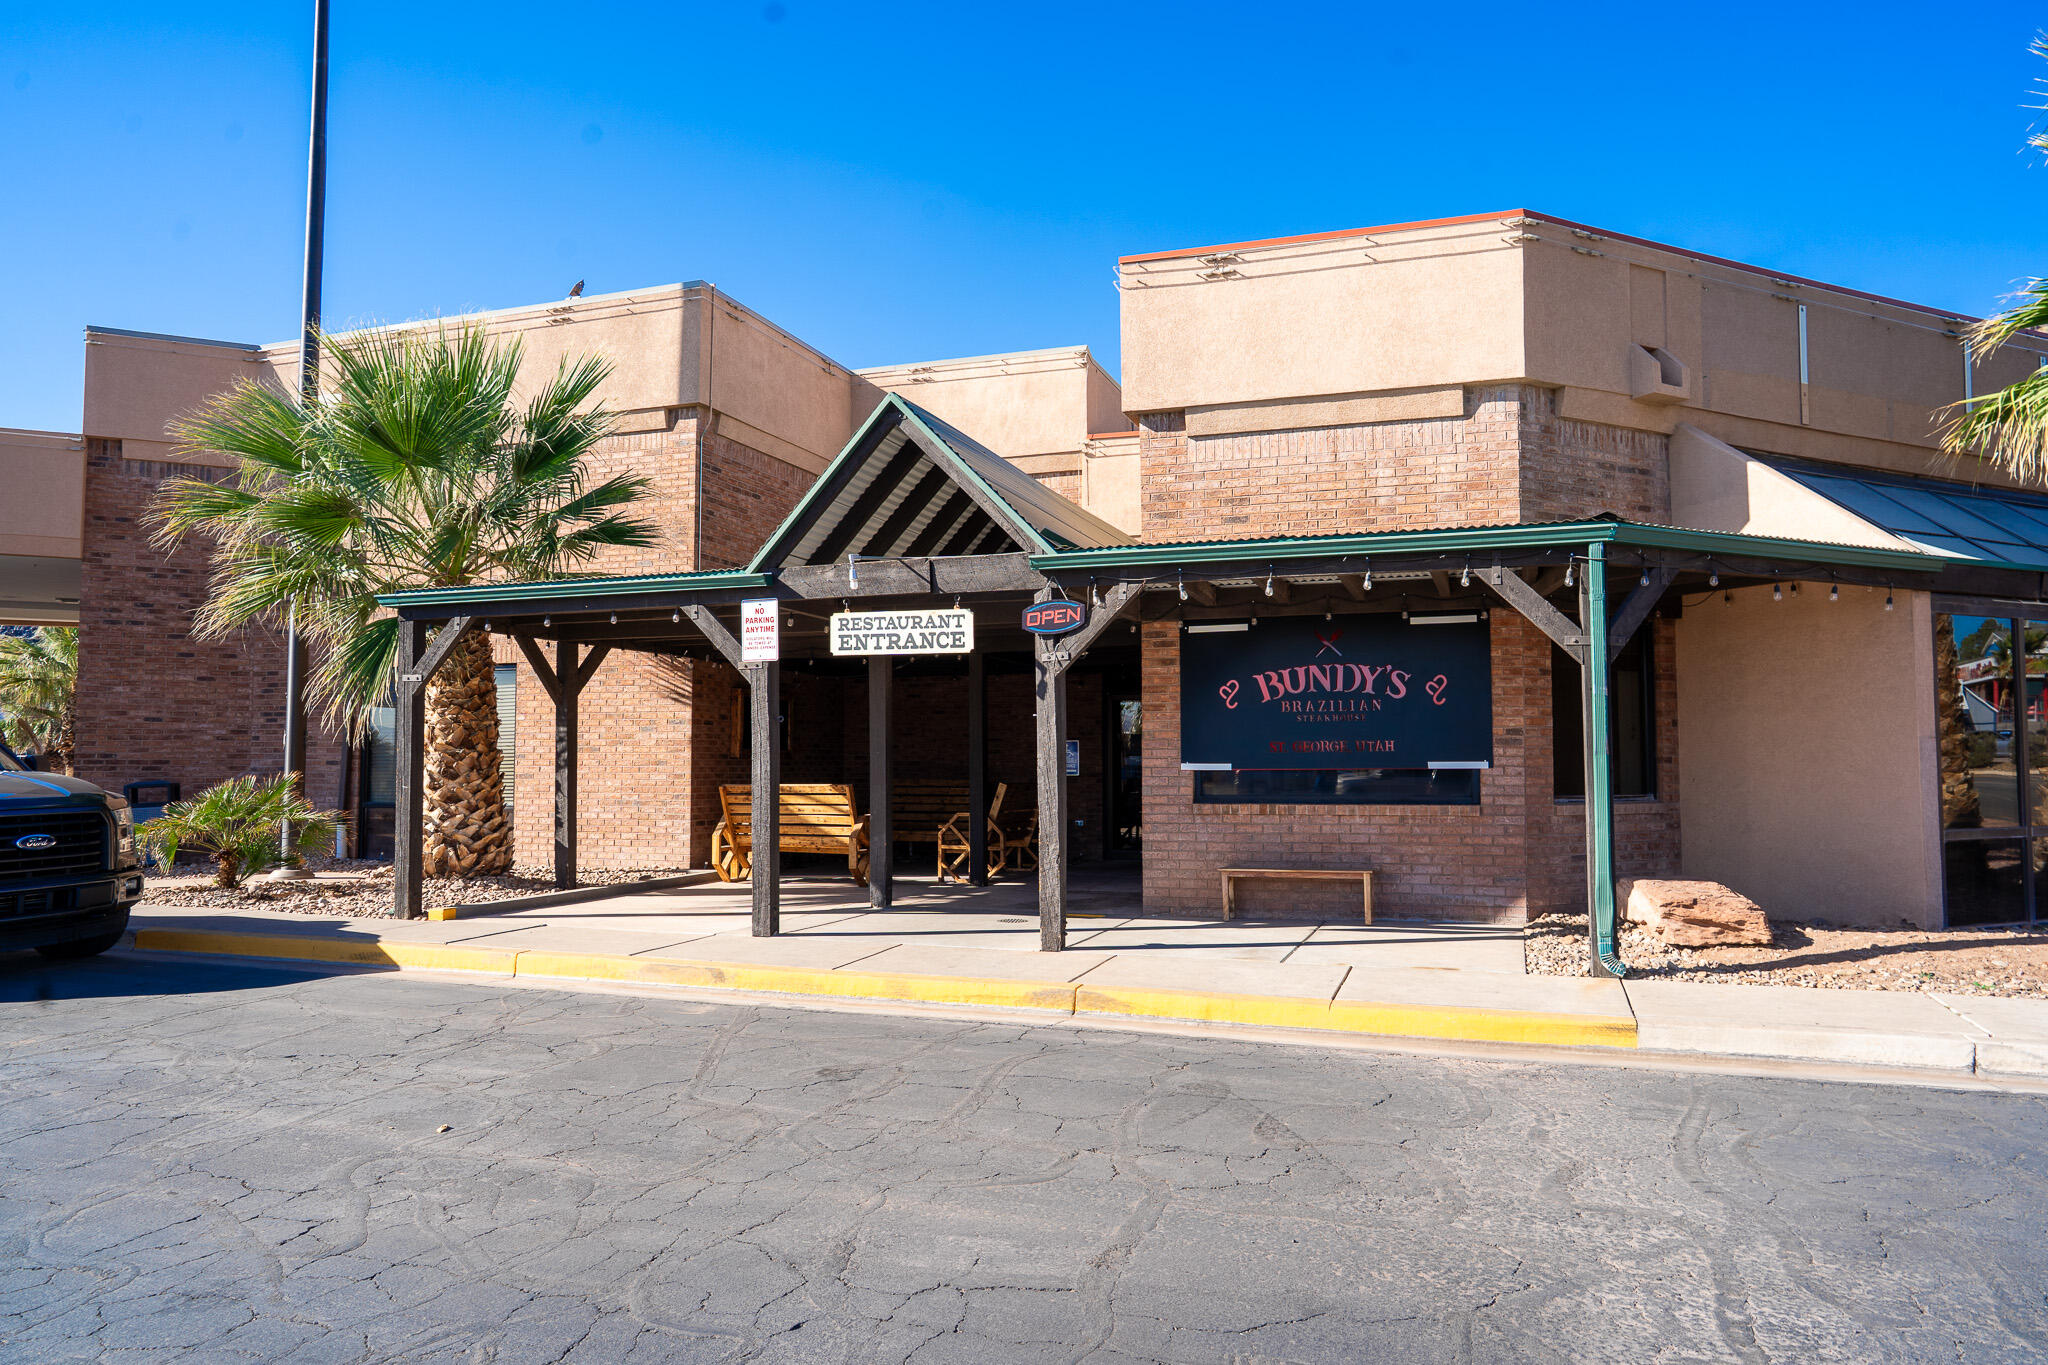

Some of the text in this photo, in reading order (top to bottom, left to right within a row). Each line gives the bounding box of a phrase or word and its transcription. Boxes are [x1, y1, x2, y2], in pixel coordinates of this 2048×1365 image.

[755, 607, 764, 615] NO
[1026, 607, 1081, 627] OPEN
[745, 616, 775, 624] PARKING
[837, 614, 966, 632] RESTAURANT
[745, 625, 775, 633] ANYTIME
[838, 631, 966, 651] ENTRANCE
[1251, 662, 1412, 703] BUNDY'S
[1280, 699, 1382, 713] BRAZILIAN
[1296, 713, 1367, 722] STEAKHOUSE
[1355, 739, 1395, 753] UTAH
[26, 838, 48, 847] Ford
